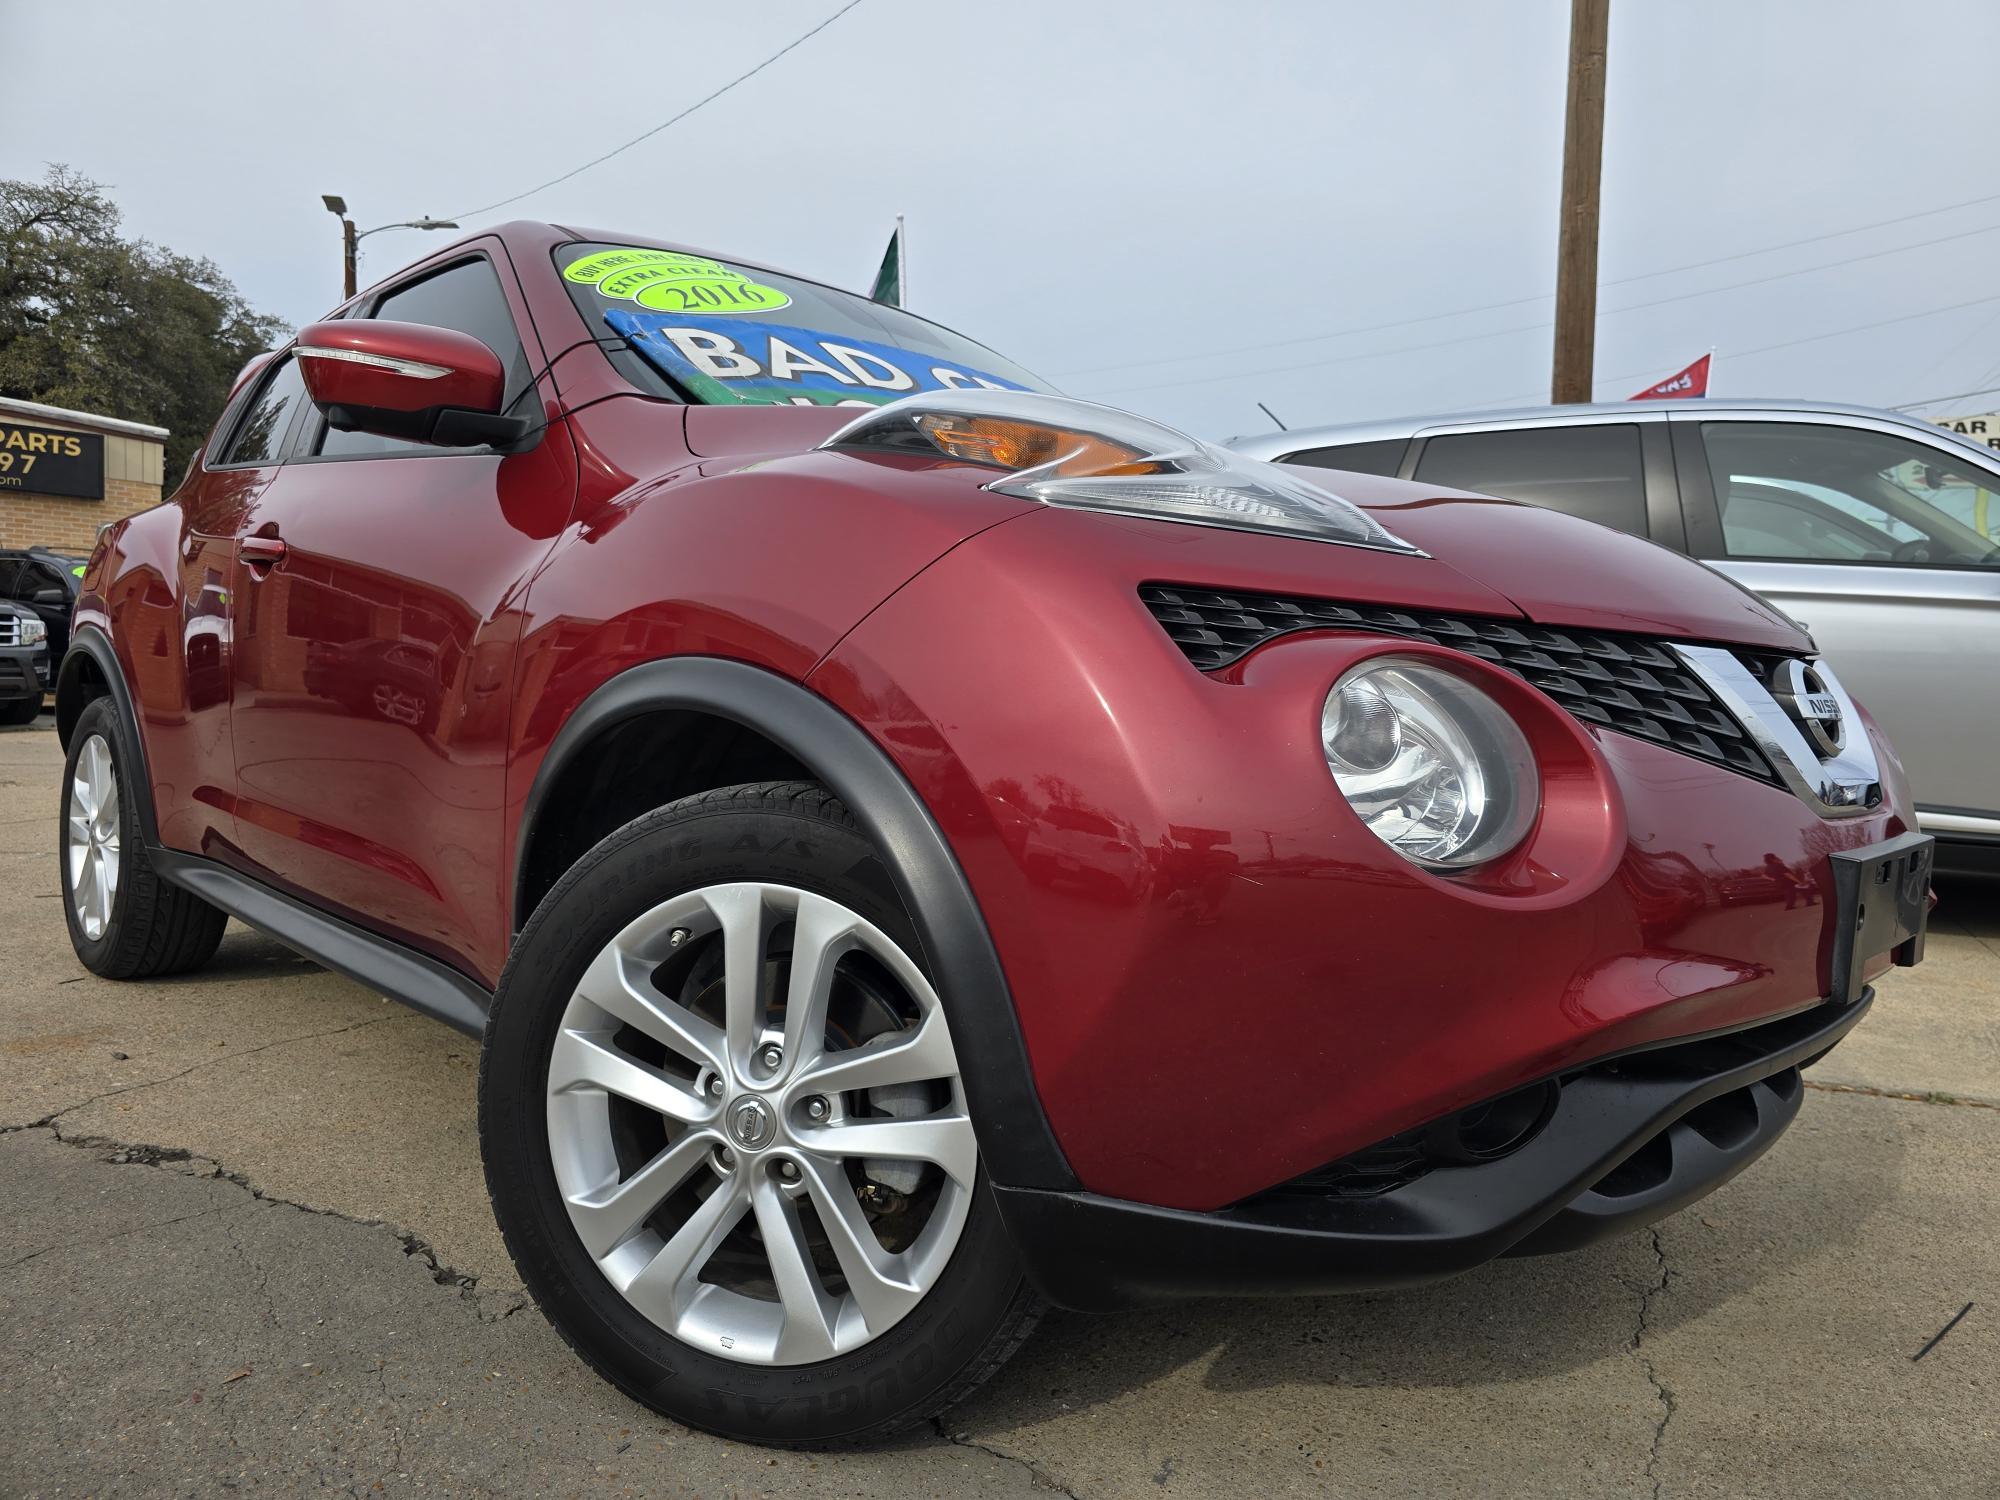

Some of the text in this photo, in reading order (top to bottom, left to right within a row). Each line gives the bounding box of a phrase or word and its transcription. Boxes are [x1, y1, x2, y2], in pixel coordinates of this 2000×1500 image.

[576, 262, 600, 278] BUY
[598, 256, 631, 267] HERE
[608, 267, 737, 295] EXTRA CLEAN
[666, 283, 766, 310] 2016
[660, 326, 916, 391] BAD
